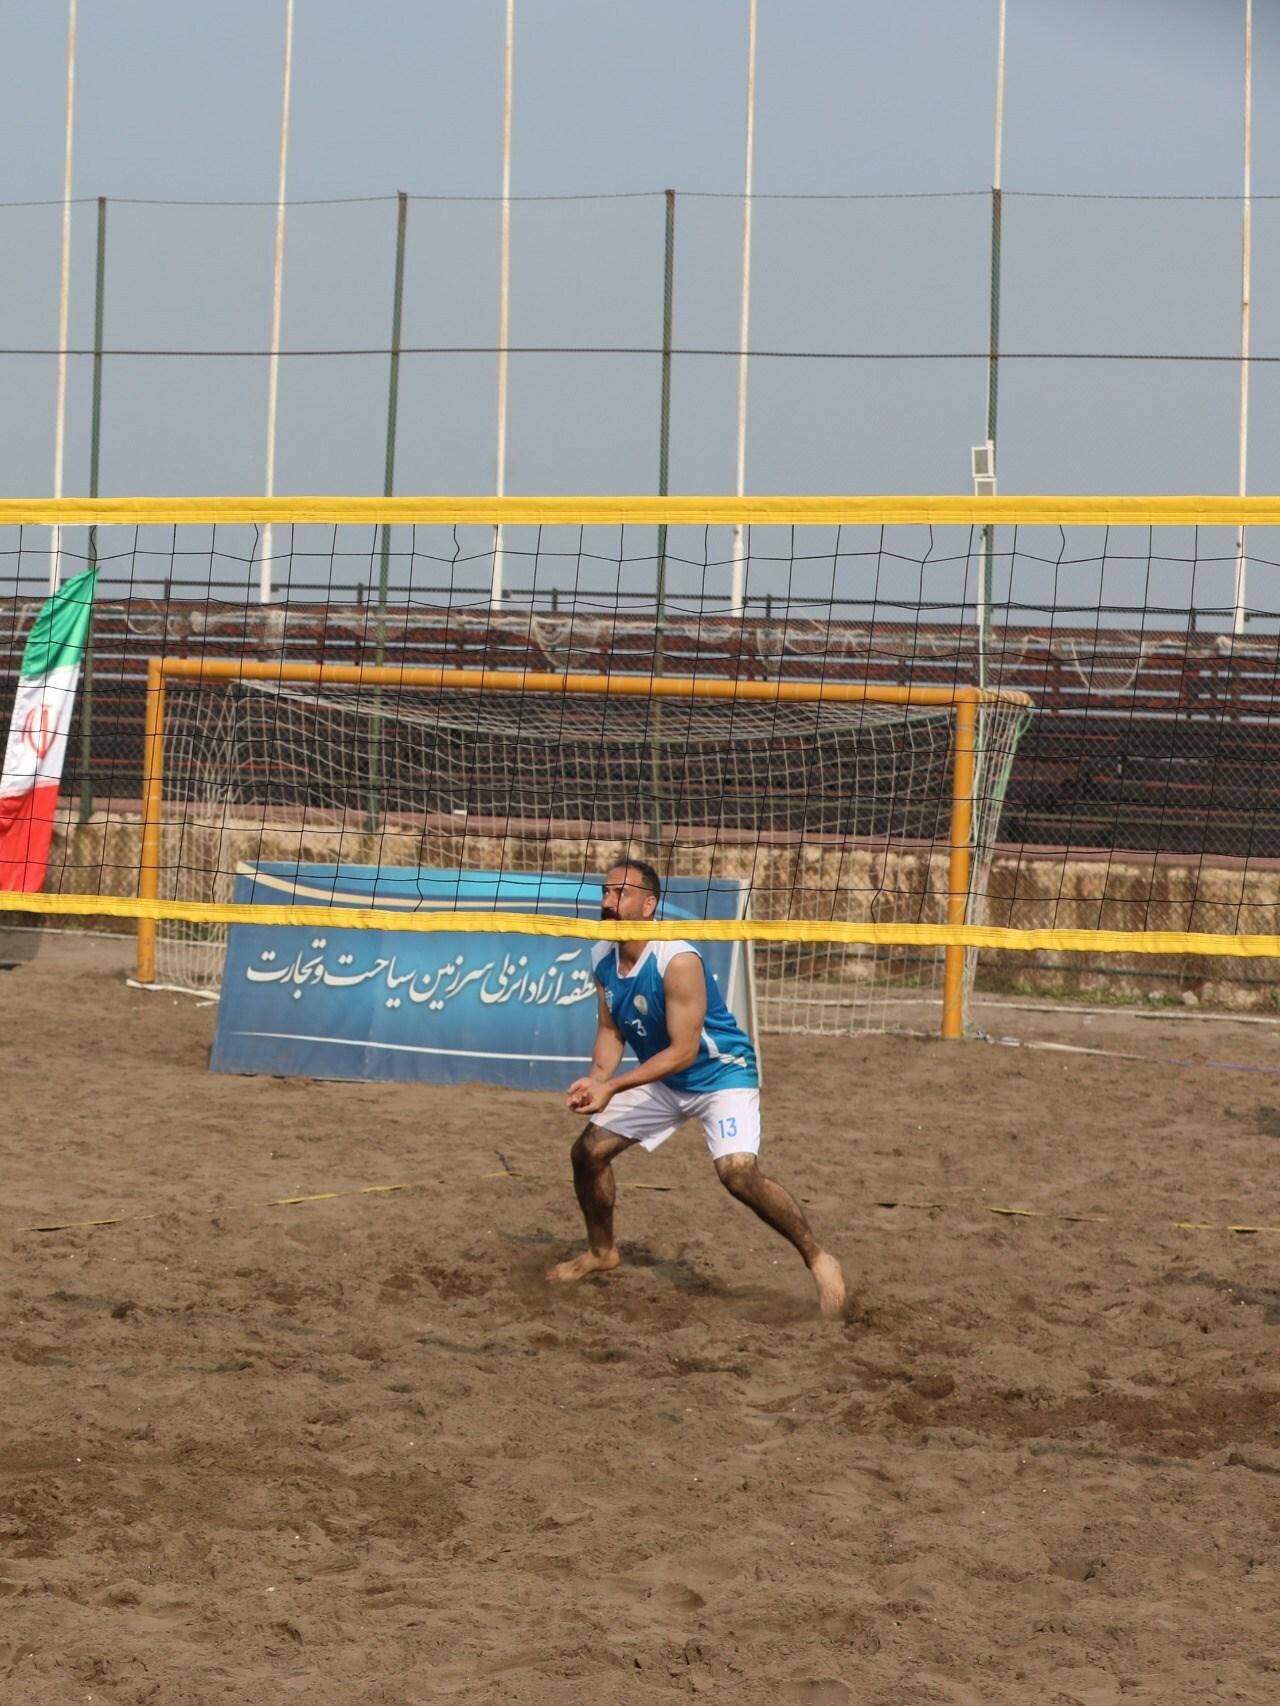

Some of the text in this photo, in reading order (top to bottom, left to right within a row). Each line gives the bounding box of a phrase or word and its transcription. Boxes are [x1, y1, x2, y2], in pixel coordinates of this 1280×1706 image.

[323, 953, 417, 1009] سیاحت
[409, 954, 496, 1011] سرزمین
[524, 948, 583, 1005] آزاد
[718, 1117, 738, 1139] 13
